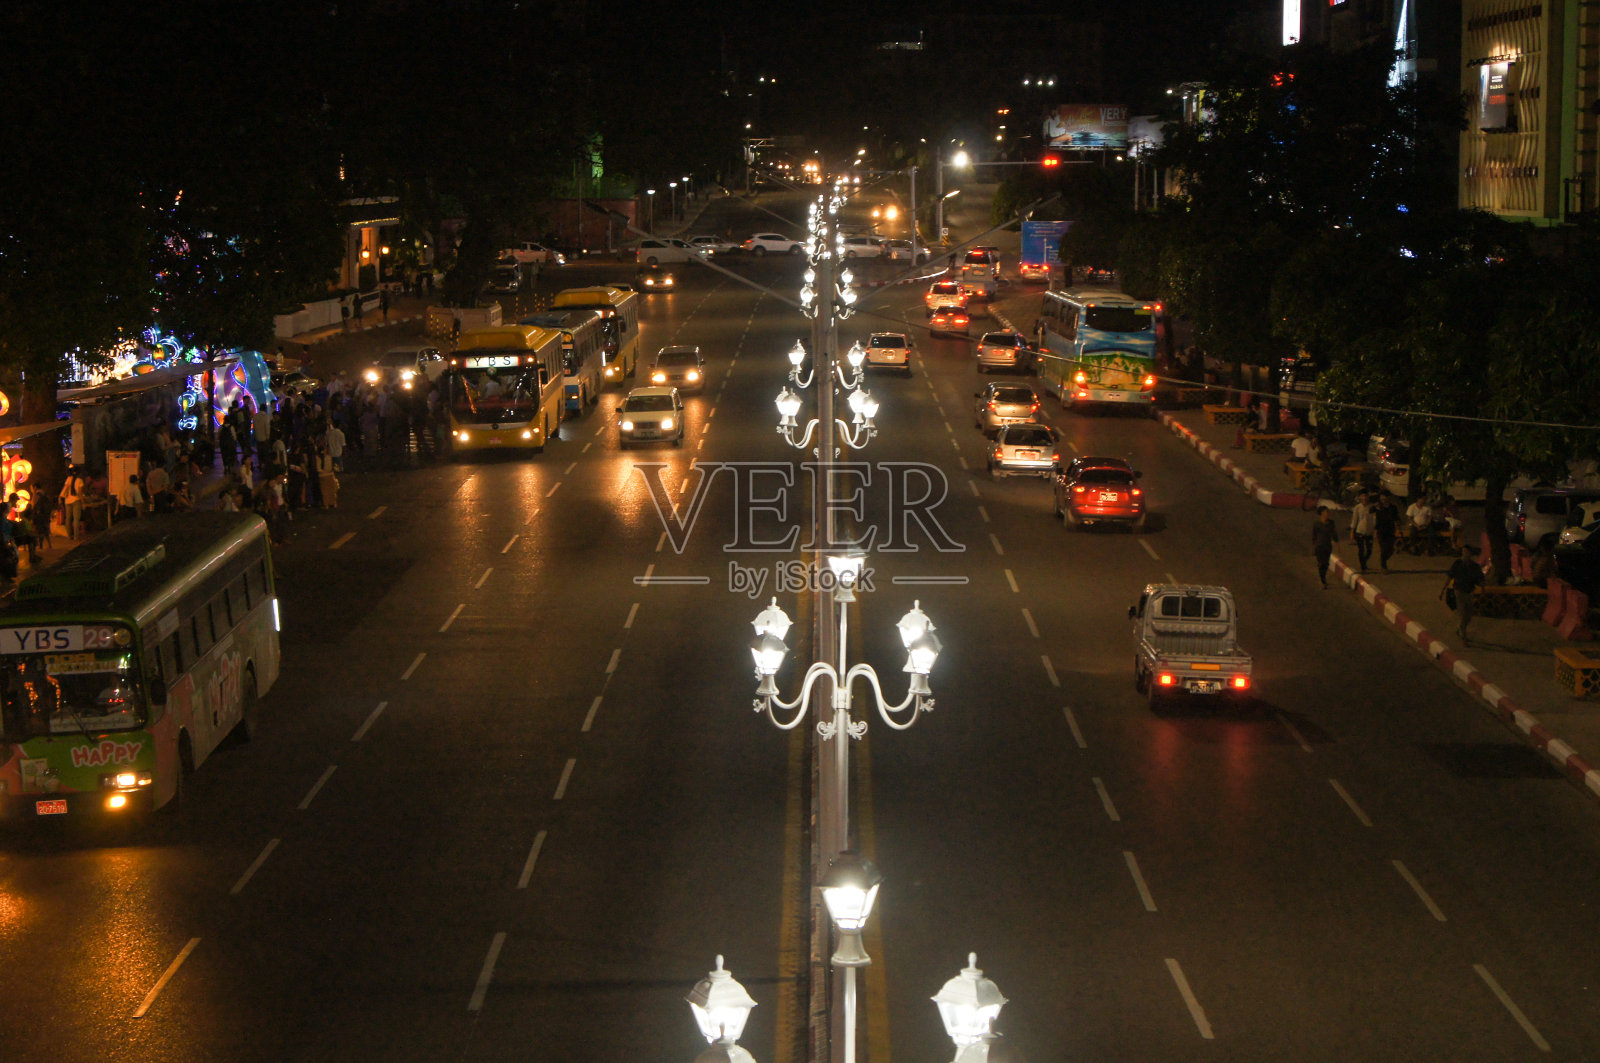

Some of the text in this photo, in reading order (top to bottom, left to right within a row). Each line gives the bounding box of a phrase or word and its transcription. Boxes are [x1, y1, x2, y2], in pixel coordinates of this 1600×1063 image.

[14, 628, 112, 651] YBS 29
[72, 741, 141, 767] HAPPY
